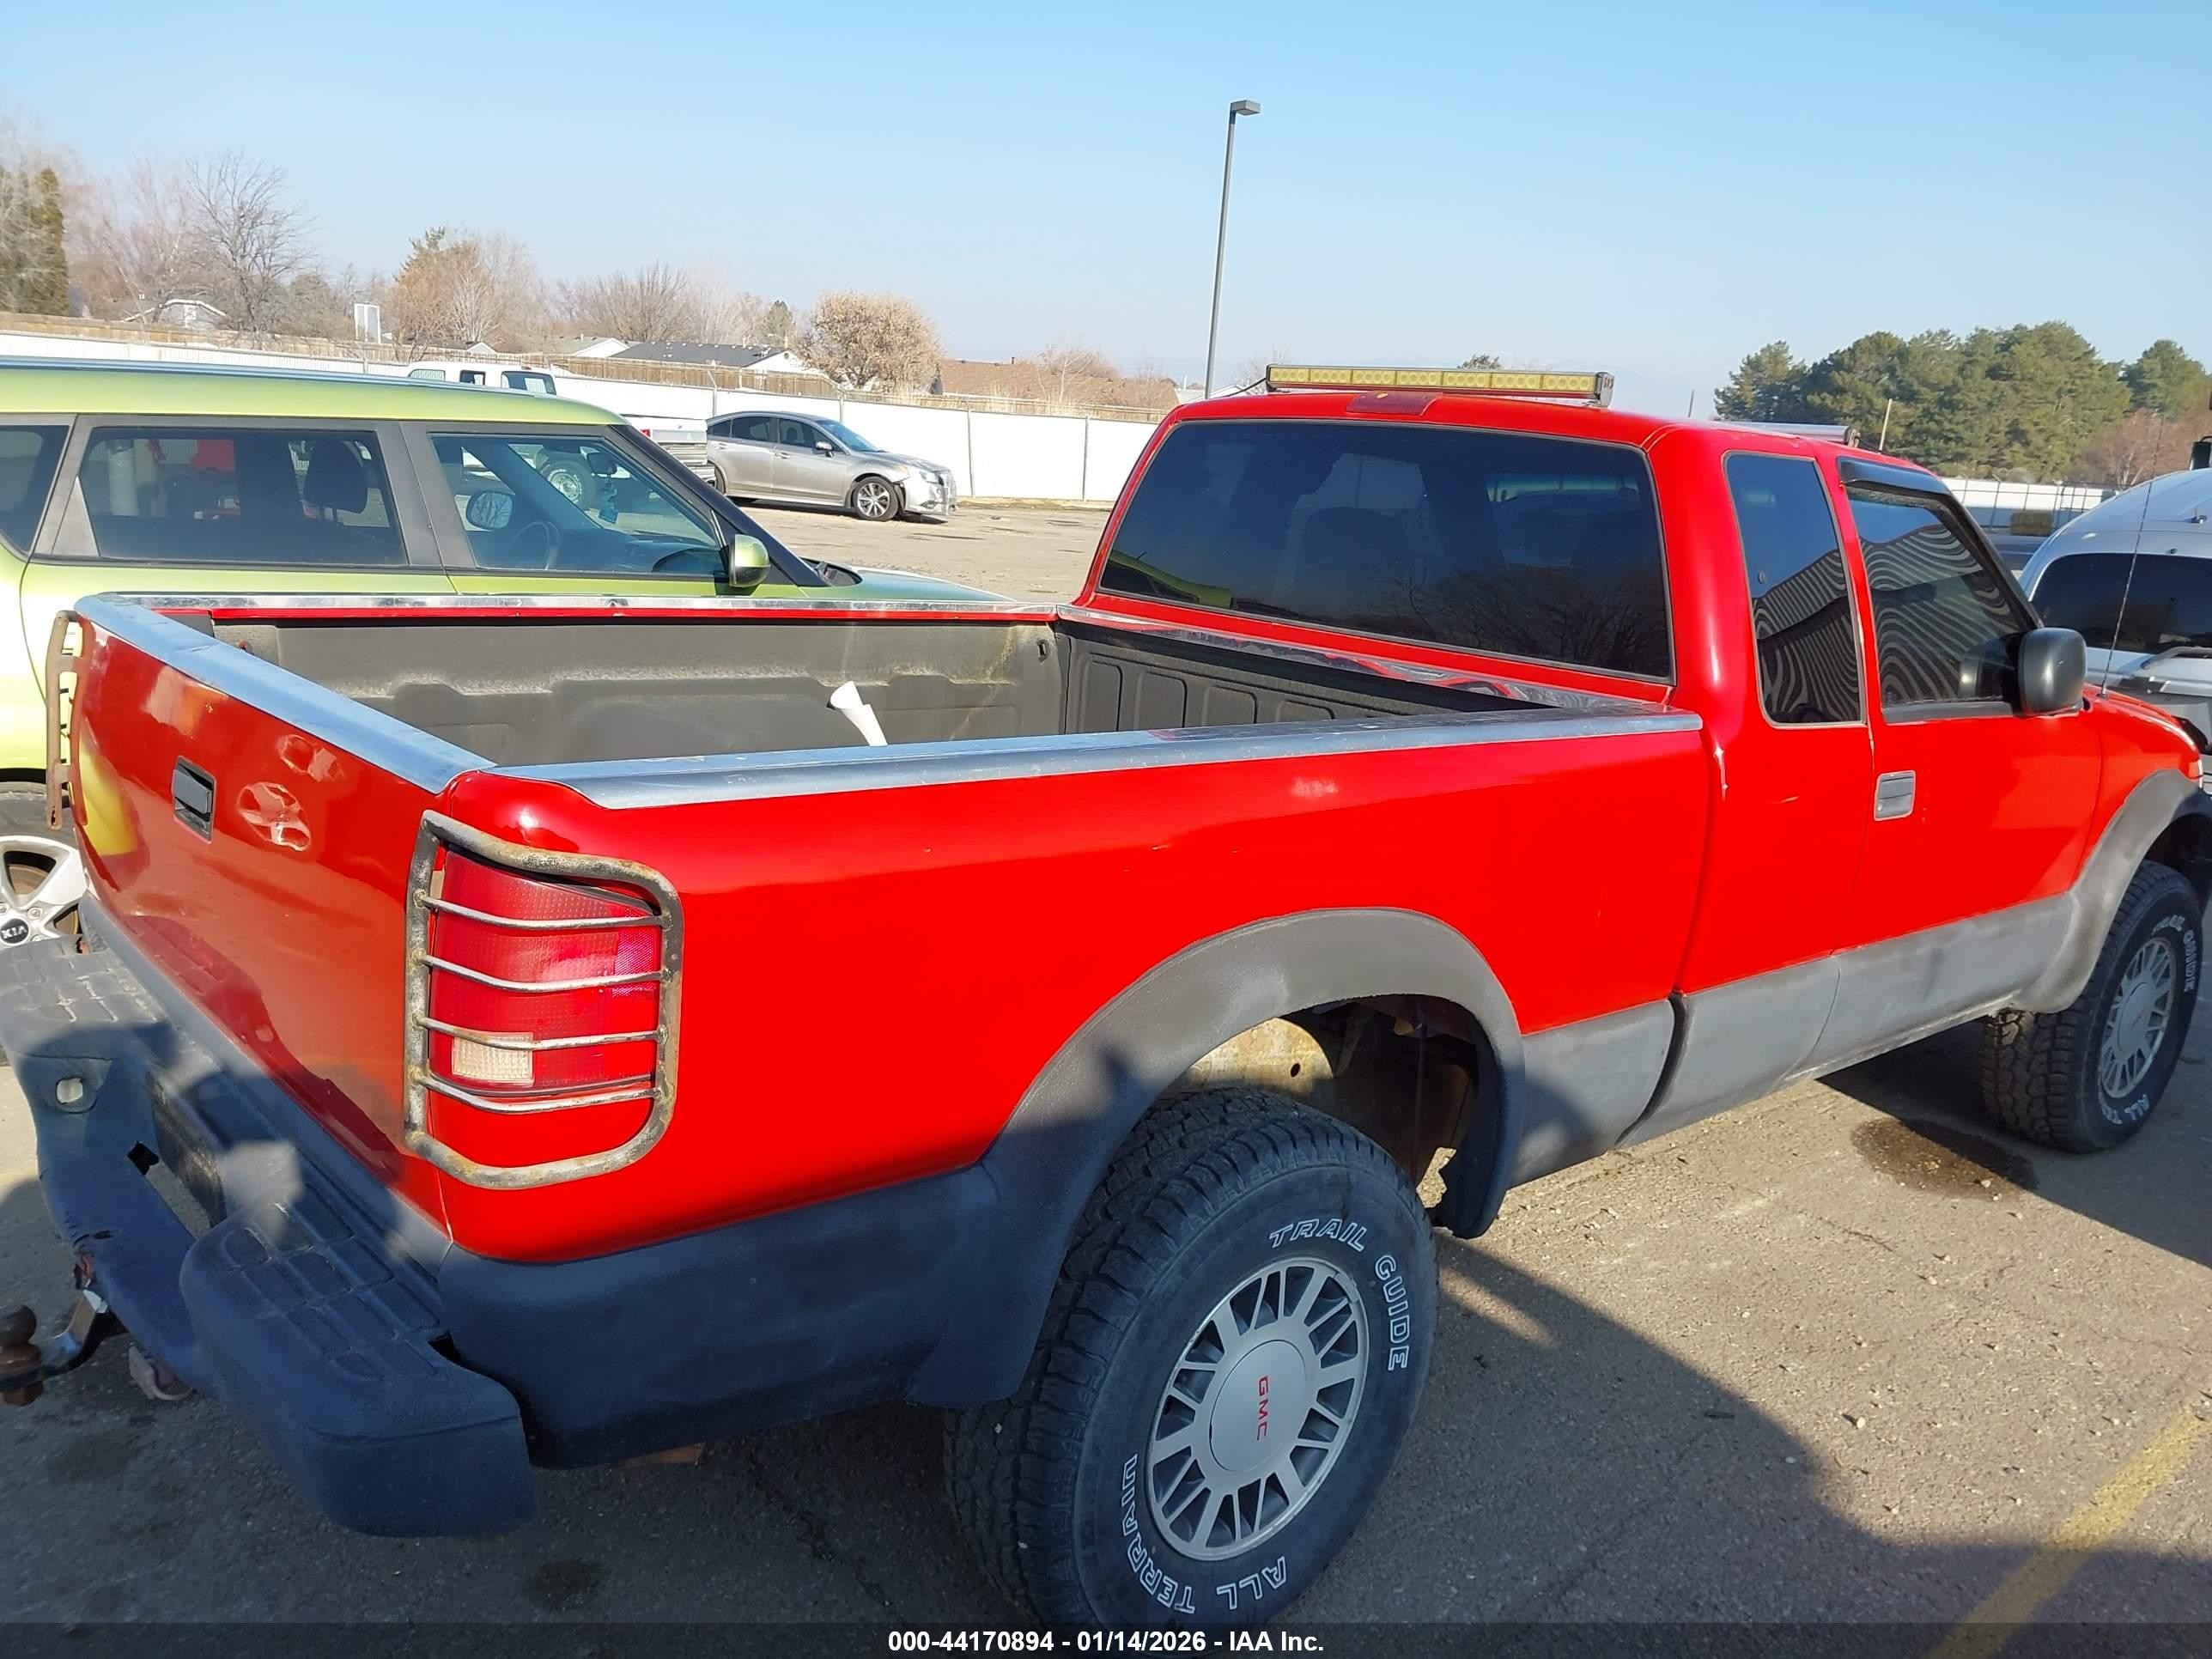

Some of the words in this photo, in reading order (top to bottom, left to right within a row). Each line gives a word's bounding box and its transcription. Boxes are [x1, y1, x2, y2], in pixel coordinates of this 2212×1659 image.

[1, 926, 27, 939] KIA
[1269, 1218, 1368, 1253] TRAIL
[1375, 1255, 1411, 1372] GUIDE
[1256, 1375, 1269, 1441] GMC
[1121, 1453, 1196, 1614] TERRAIN
[1216, 1556, 1288, 1611] ALL
